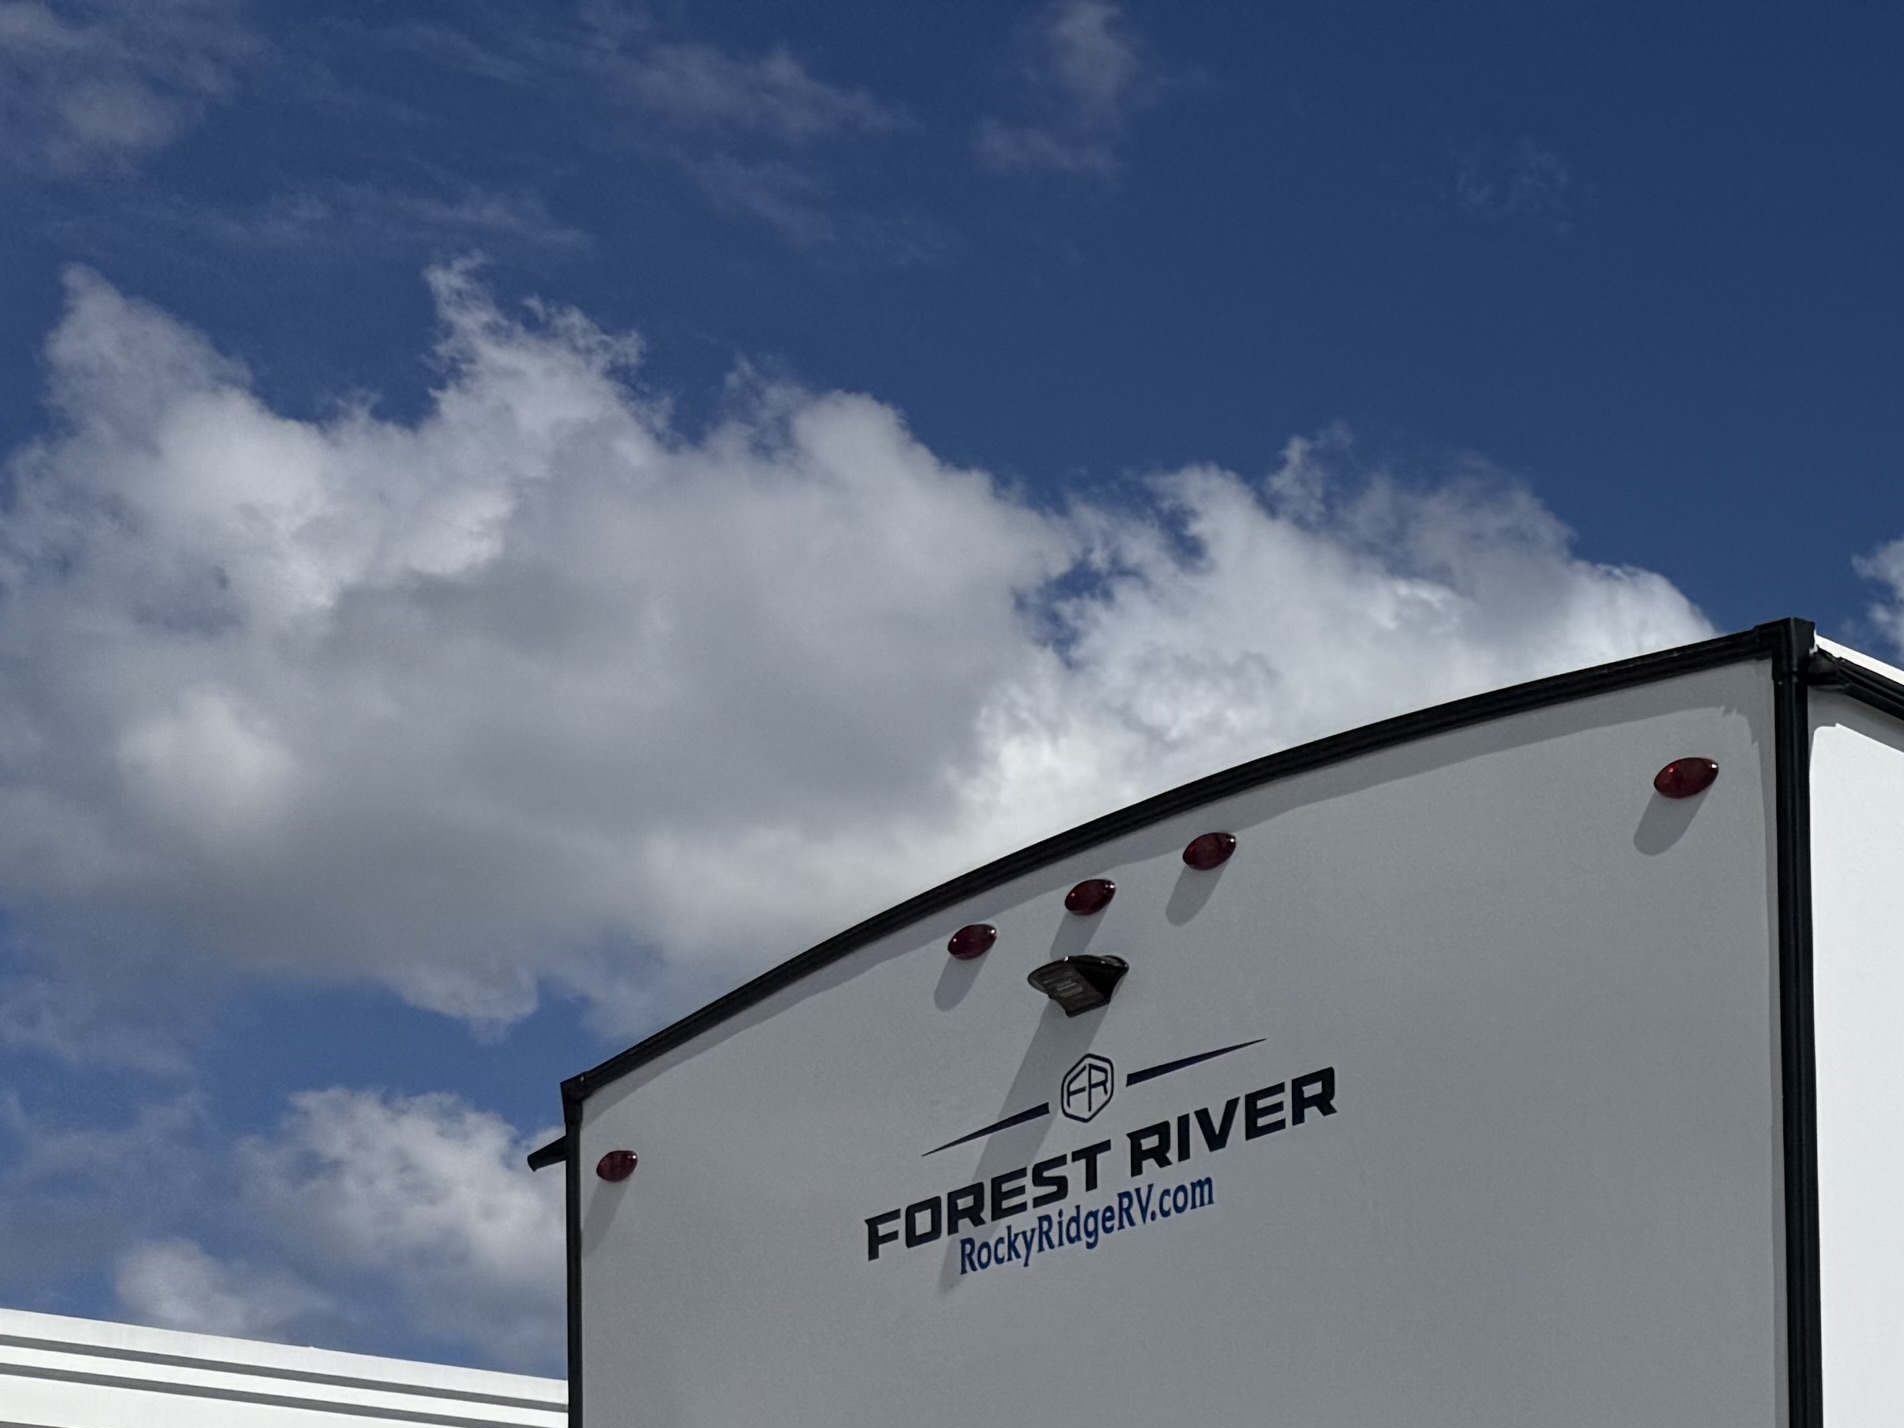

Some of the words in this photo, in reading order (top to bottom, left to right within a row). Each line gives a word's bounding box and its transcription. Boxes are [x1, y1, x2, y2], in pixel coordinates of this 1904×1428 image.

[864, 1138, 1112, 1262] FOREST
[1126, 1066, 1338, 1178] RIVER
[959, 1176, 1215, 1275] RockyRidgeRV.com
